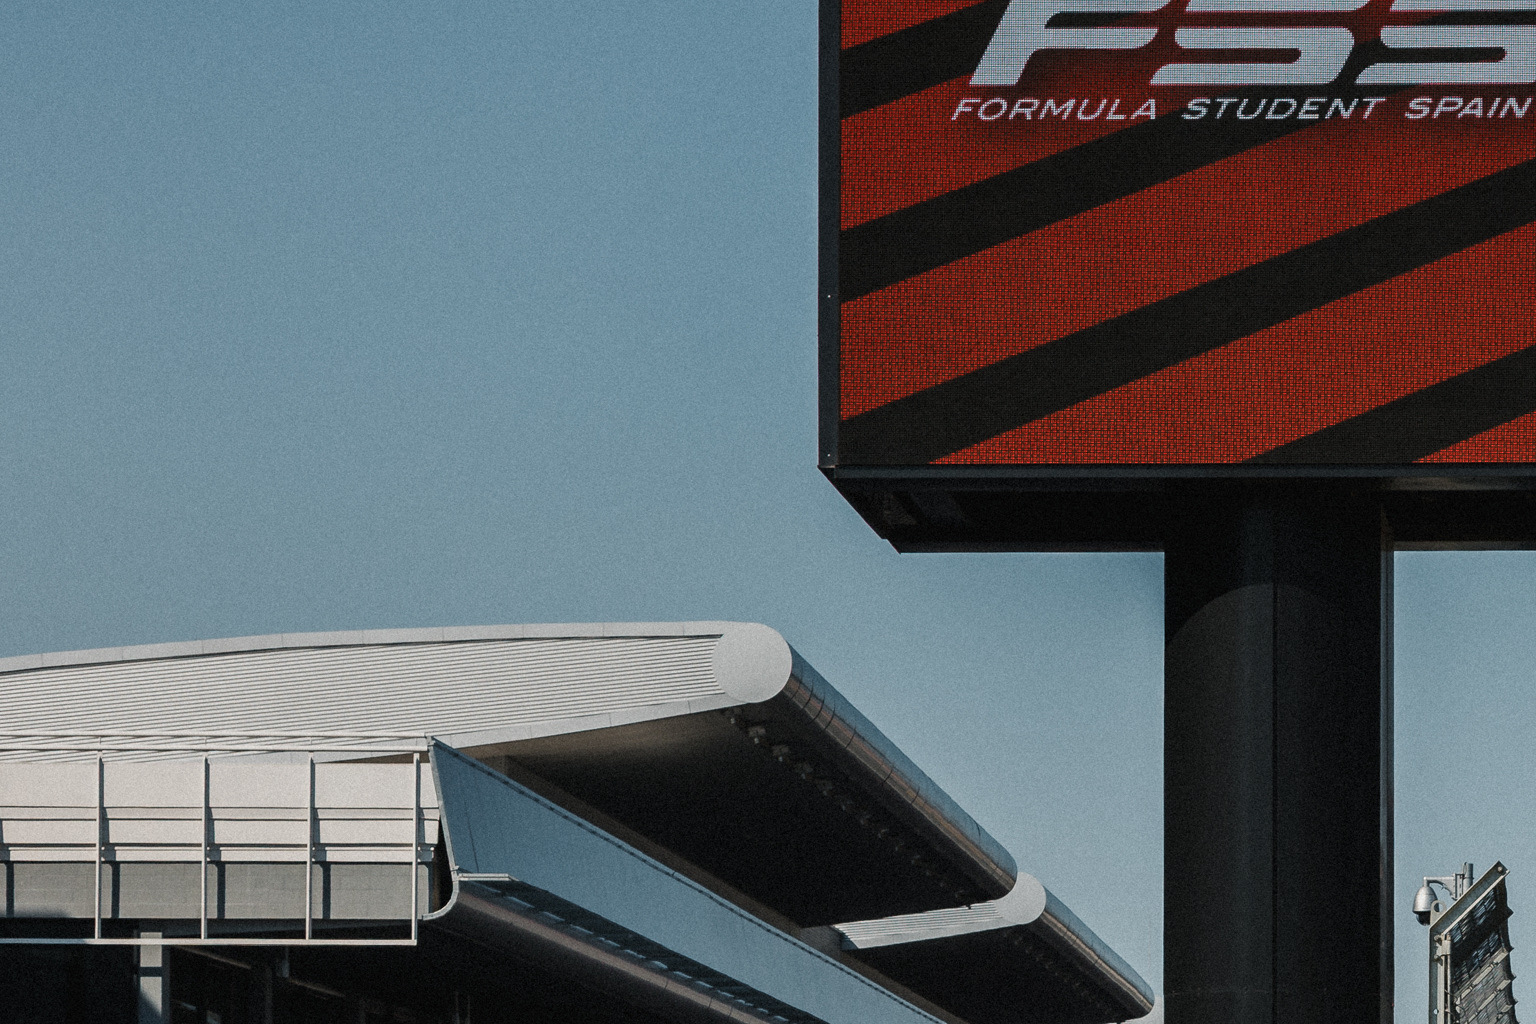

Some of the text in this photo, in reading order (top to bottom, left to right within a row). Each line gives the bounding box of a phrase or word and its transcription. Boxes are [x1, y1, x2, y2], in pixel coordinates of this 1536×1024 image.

[951, 96, 1533, 121] FORMULA STUDENT SPAIN
